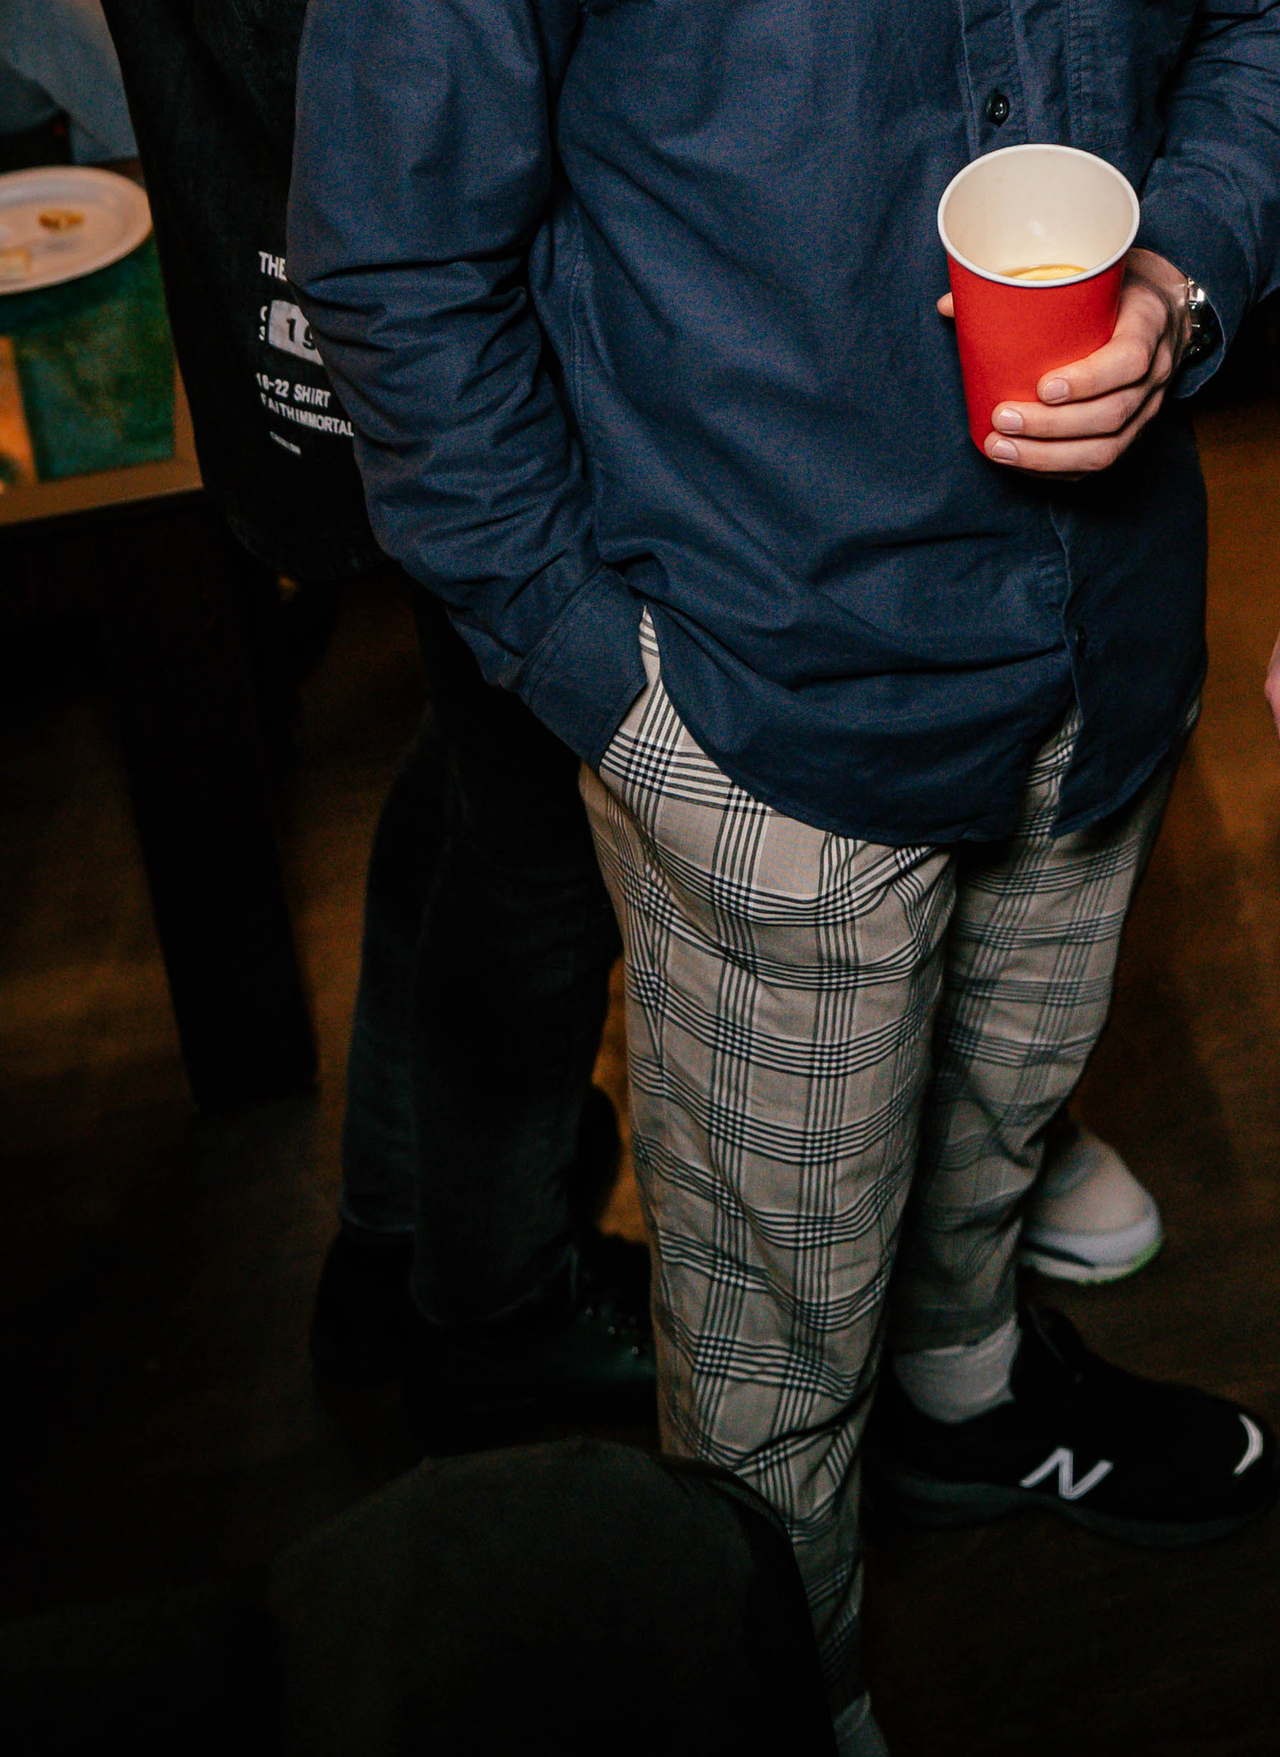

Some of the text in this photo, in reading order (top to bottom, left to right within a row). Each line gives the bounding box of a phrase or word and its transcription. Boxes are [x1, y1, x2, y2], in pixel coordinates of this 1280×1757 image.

[258, 251, 287, 281] THE
[293, 383, 331, 408] SHIRT
[1020, 1447, 1113, 1500] N
